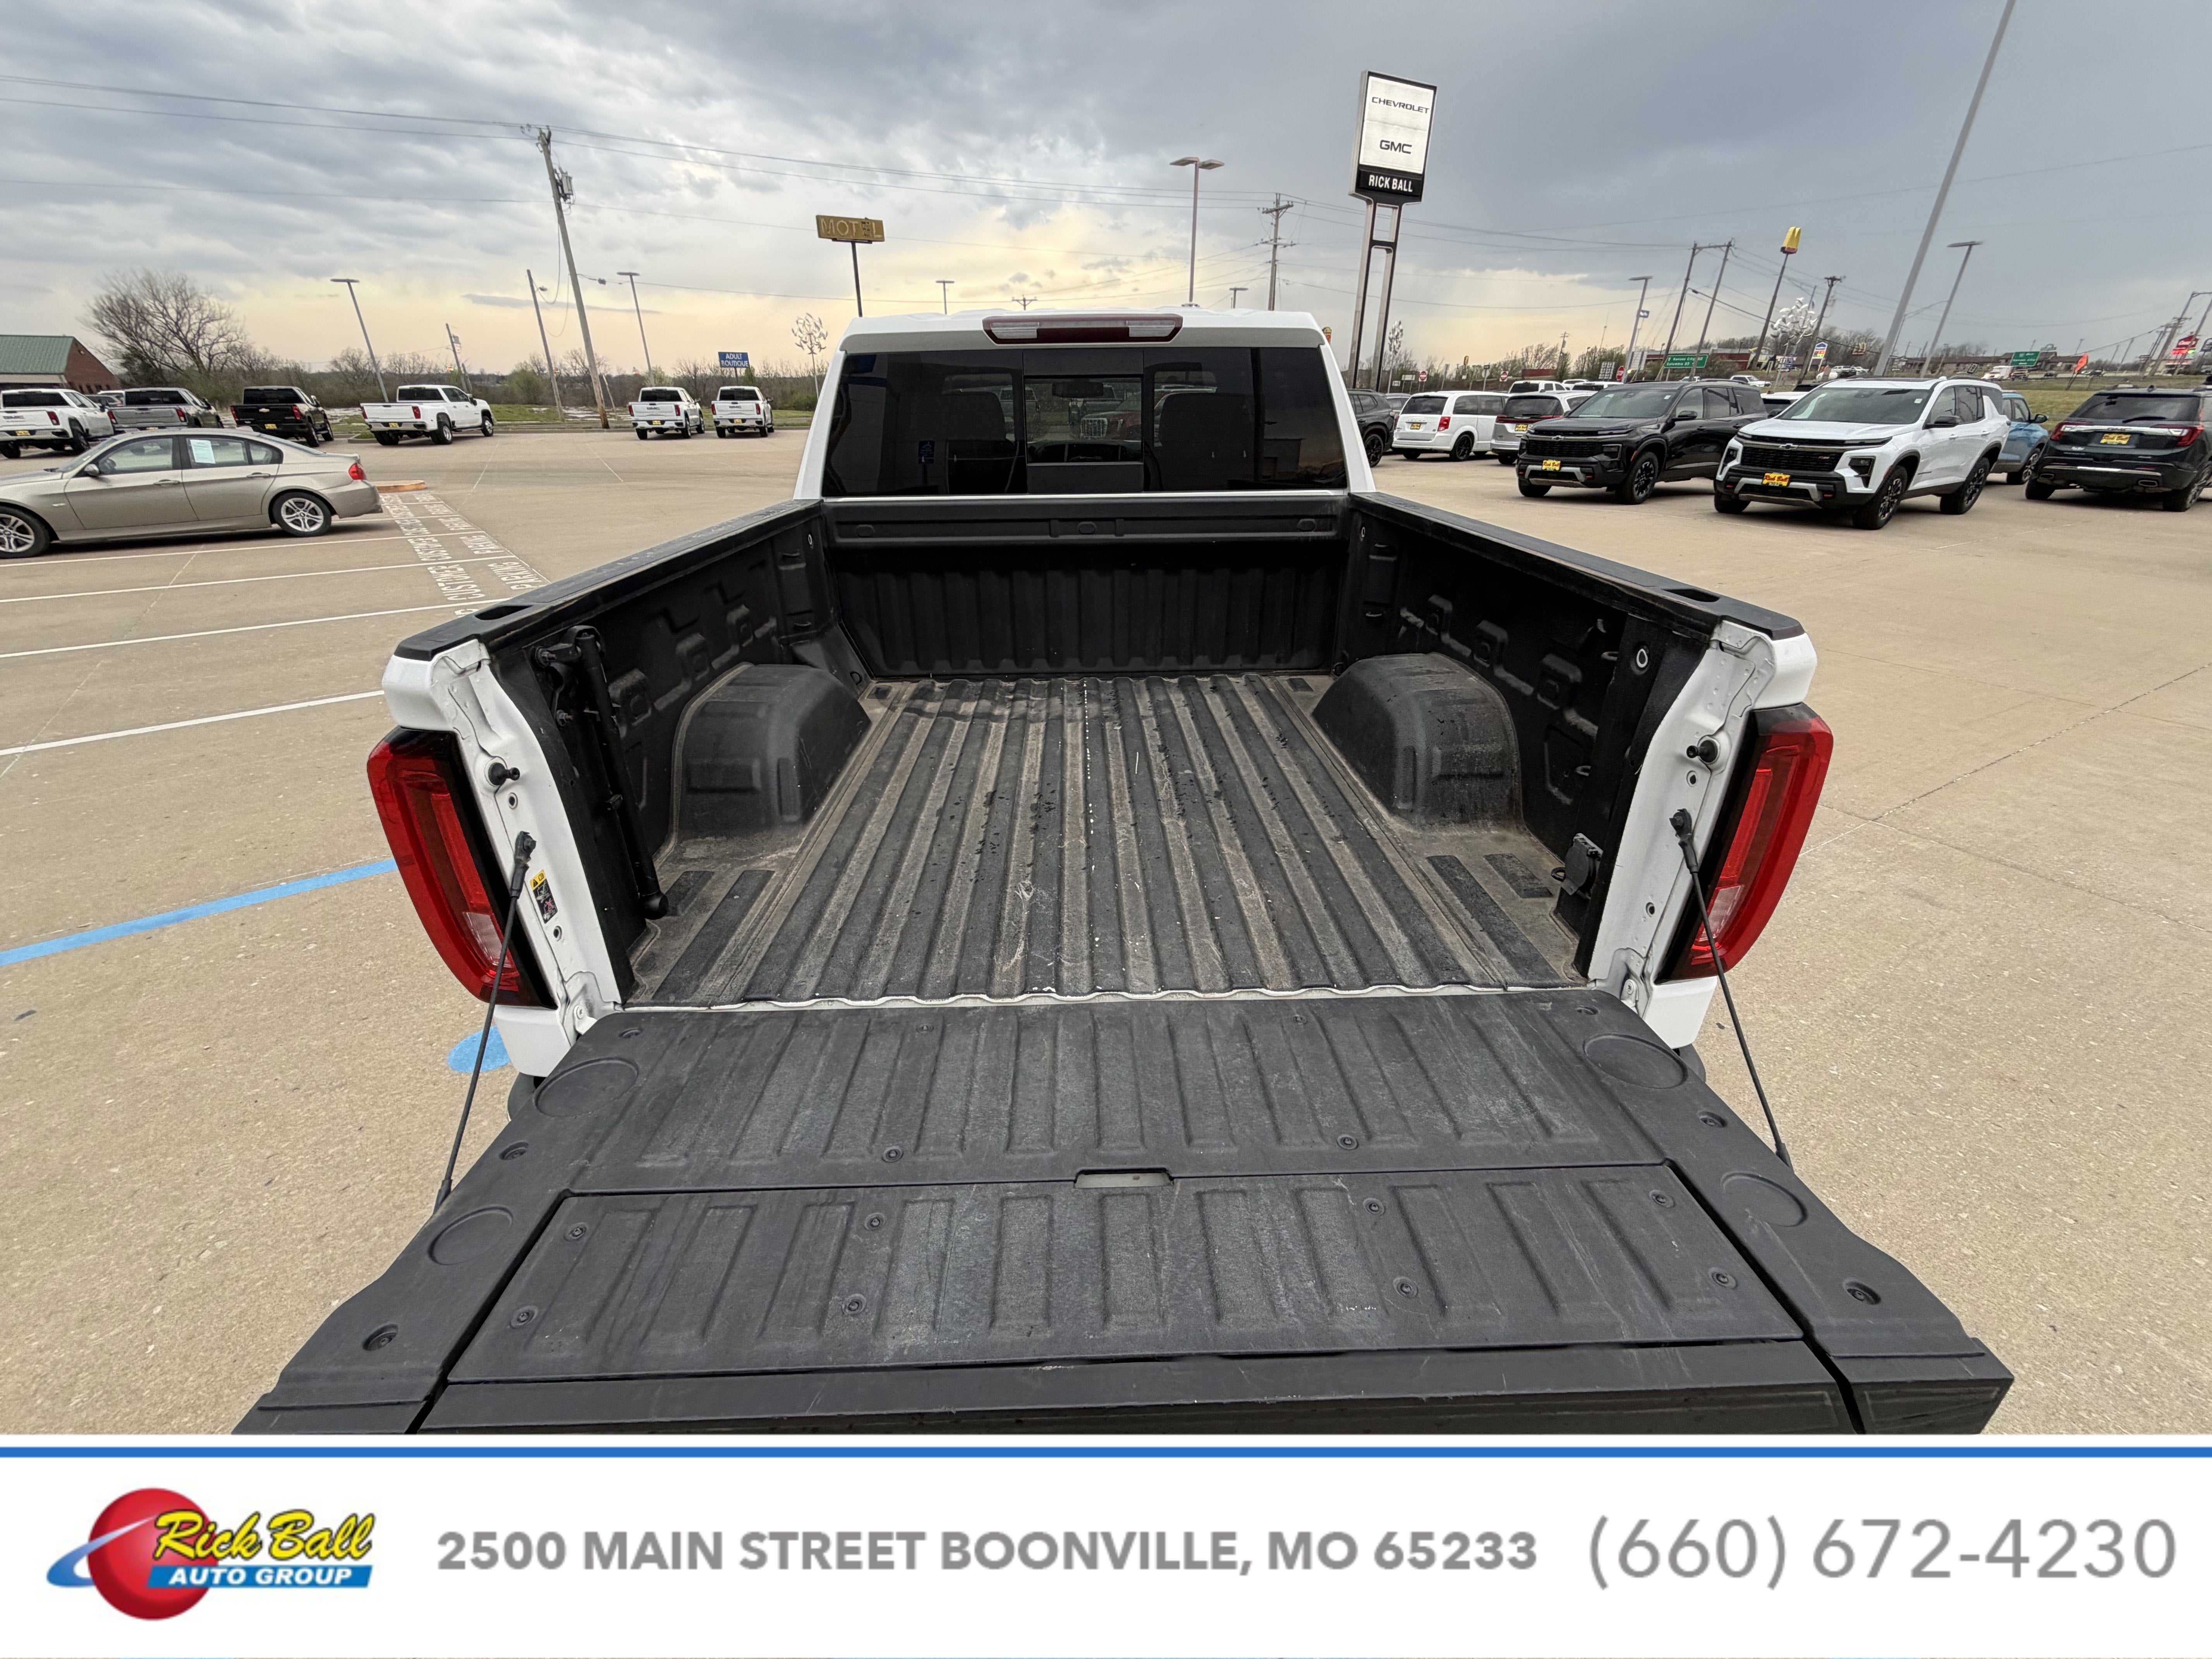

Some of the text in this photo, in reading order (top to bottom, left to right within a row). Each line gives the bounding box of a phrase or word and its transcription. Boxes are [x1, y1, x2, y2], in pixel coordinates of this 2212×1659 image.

[1372, 97, 1430, 113] CHEVROLET
[1380, 139, 1412, 155] GMC
[1369, 174, 1413, 192] RICK BALL
[820, 218, 883, 238] MOTEL
[427, 564, 486, 601] CUSTOMER
[488, 562, 542, 590] PARKING
